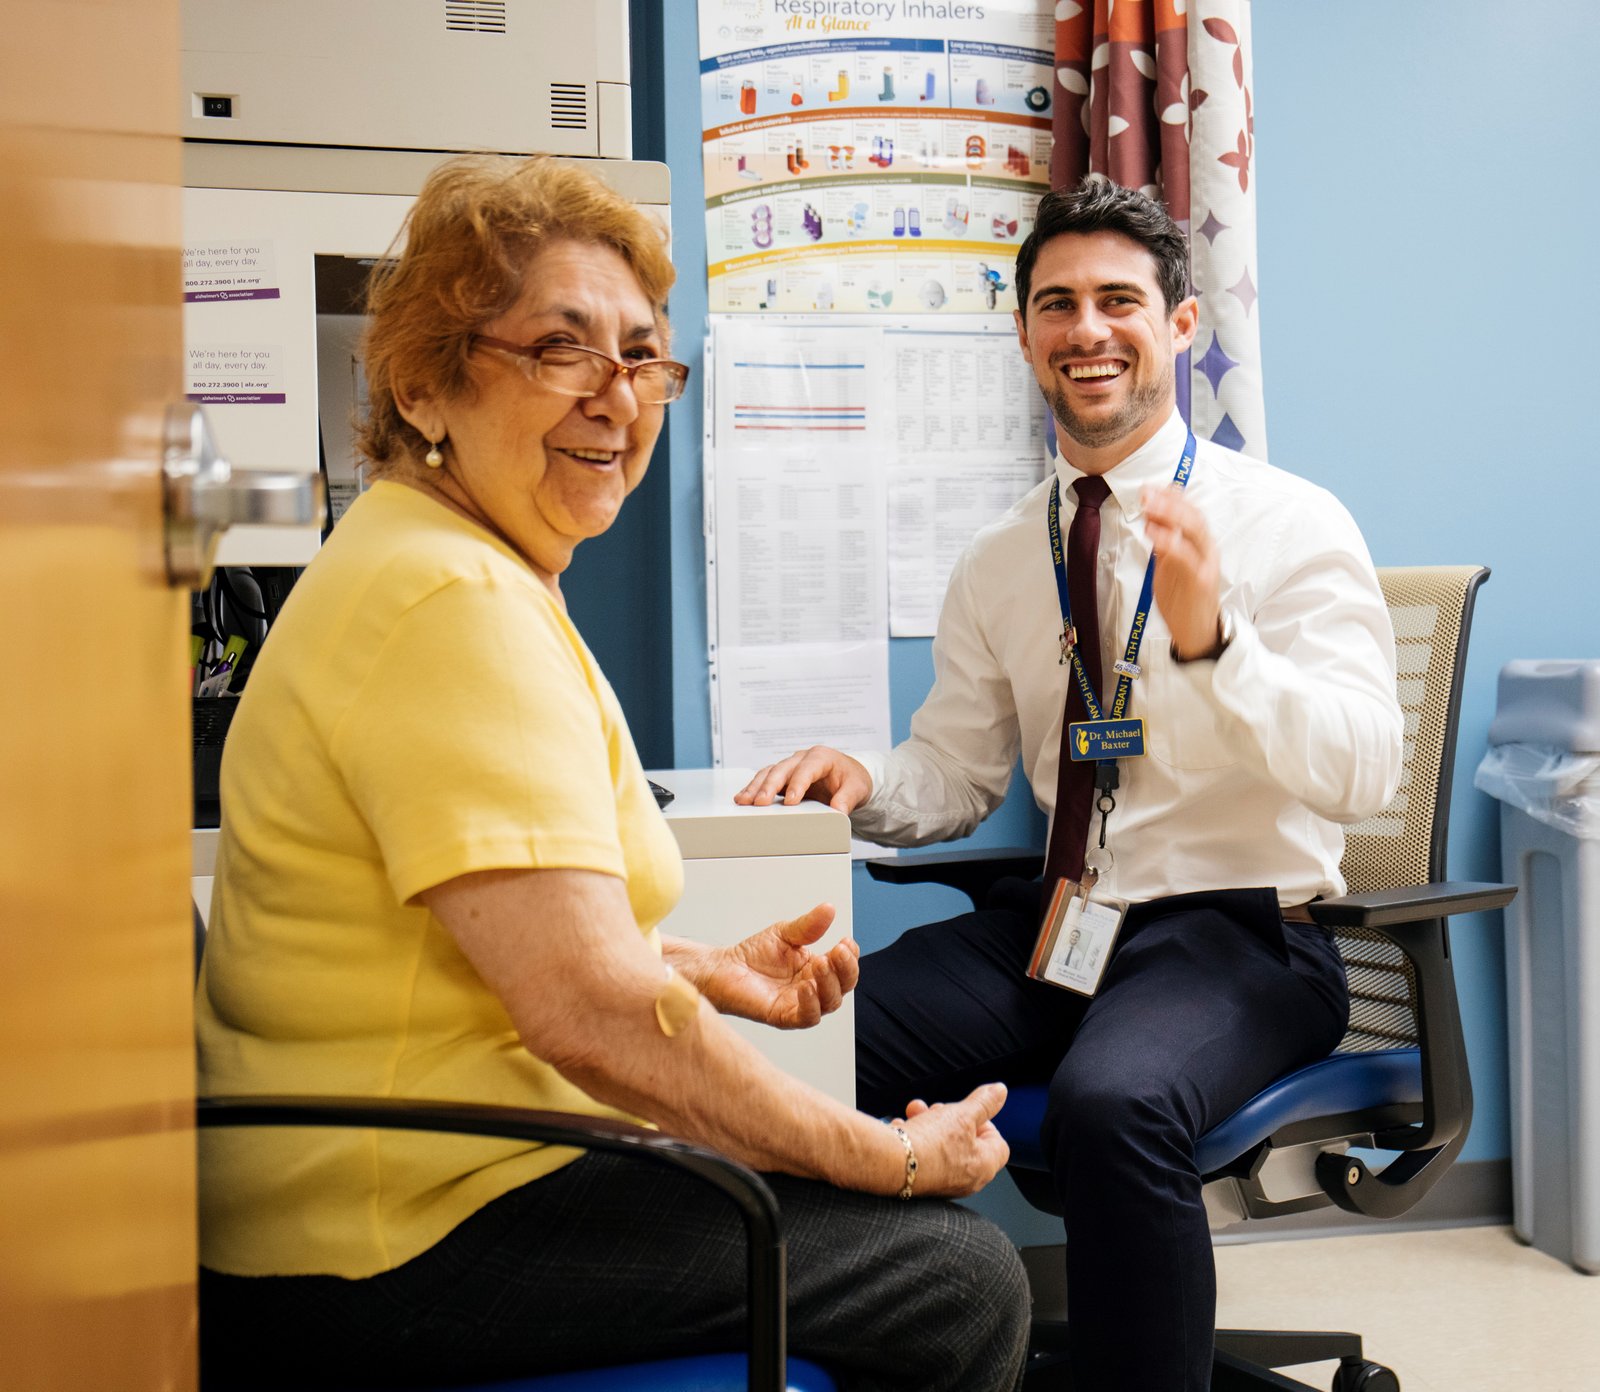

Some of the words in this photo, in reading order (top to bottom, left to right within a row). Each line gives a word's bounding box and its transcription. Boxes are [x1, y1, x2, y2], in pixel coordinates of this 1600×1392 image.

[775, 0, 895, 20] Respiratory
[903, 0, 985, 19] Inhalers
[806, 18, 816, 30] a
[820, 15, 871, 33] Glance
[181, 248, 205, 256] We're
[208, 247, 228, 255] here
[230, 247, 241, 255] for
[244, 247, 260, 256] you
[184, 259, 193, 268] all
[195, 258, 213, 269] day,
[215, 258, 239, 268] every
[189, 350, 216, 359] We're
[218, 350, 238, 358] here
[240, 349, 252, 358] for
[254, 350, 270, 360] you
[192, 361, 203, 369] all
[204, 361, 222, 371] day,
[224, 362, 249, 371] every
[1176, 455, 1192, 481] PLAN
[1049, 500, 1059, 538] HEALTH
[1052, 538, 1062, 565] PLAN
[1112, 684, 1129, 720] URBAN
[1121, 641, 1138, 682] HLTH
[1131, 611, 1146, 640] PLAN
[1084, 691, 1101, 719] PLAN
[1089, 731, 1103, 740] Dr.
[1105, 728, 1141, 740] Michael
[1101, 741, 1131, 751] Baxter
